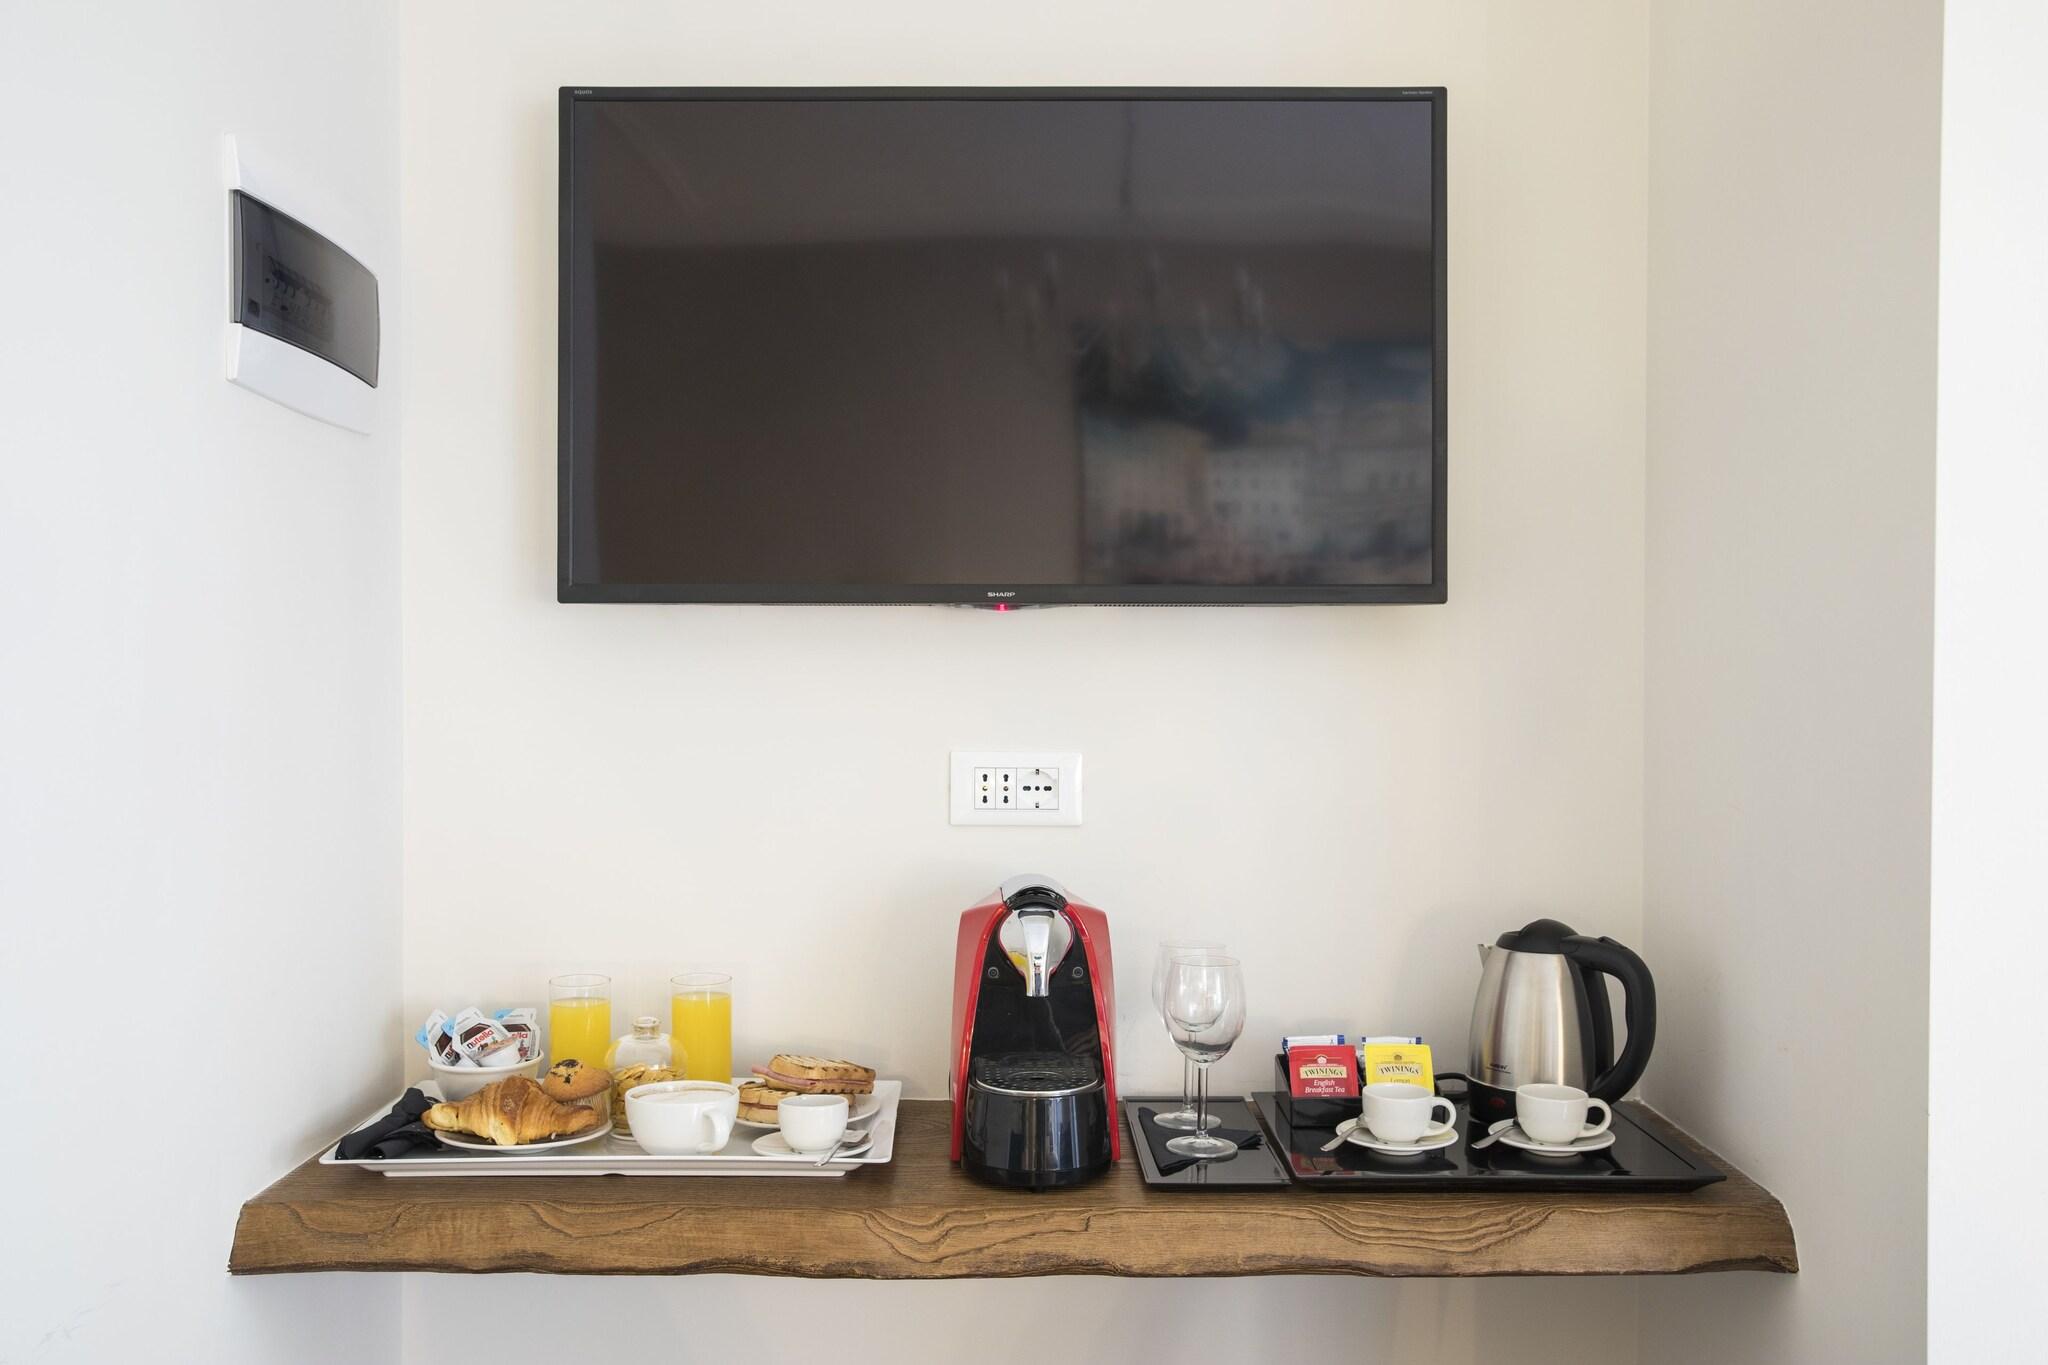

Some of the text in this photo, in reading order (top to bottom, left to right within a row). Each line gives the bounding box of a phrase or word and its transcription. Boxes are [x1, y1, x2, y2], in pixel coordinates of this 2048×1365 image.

[466, 1029, 495, 1049] nutella
[1304, 1067, 1343, 1077] TWININGS
[1380, 1065, 1419, 1075] TWININGS
[1313, 1079, 1335, 1087] English
[1305, 1086, 1333, 1094] Breakfast
